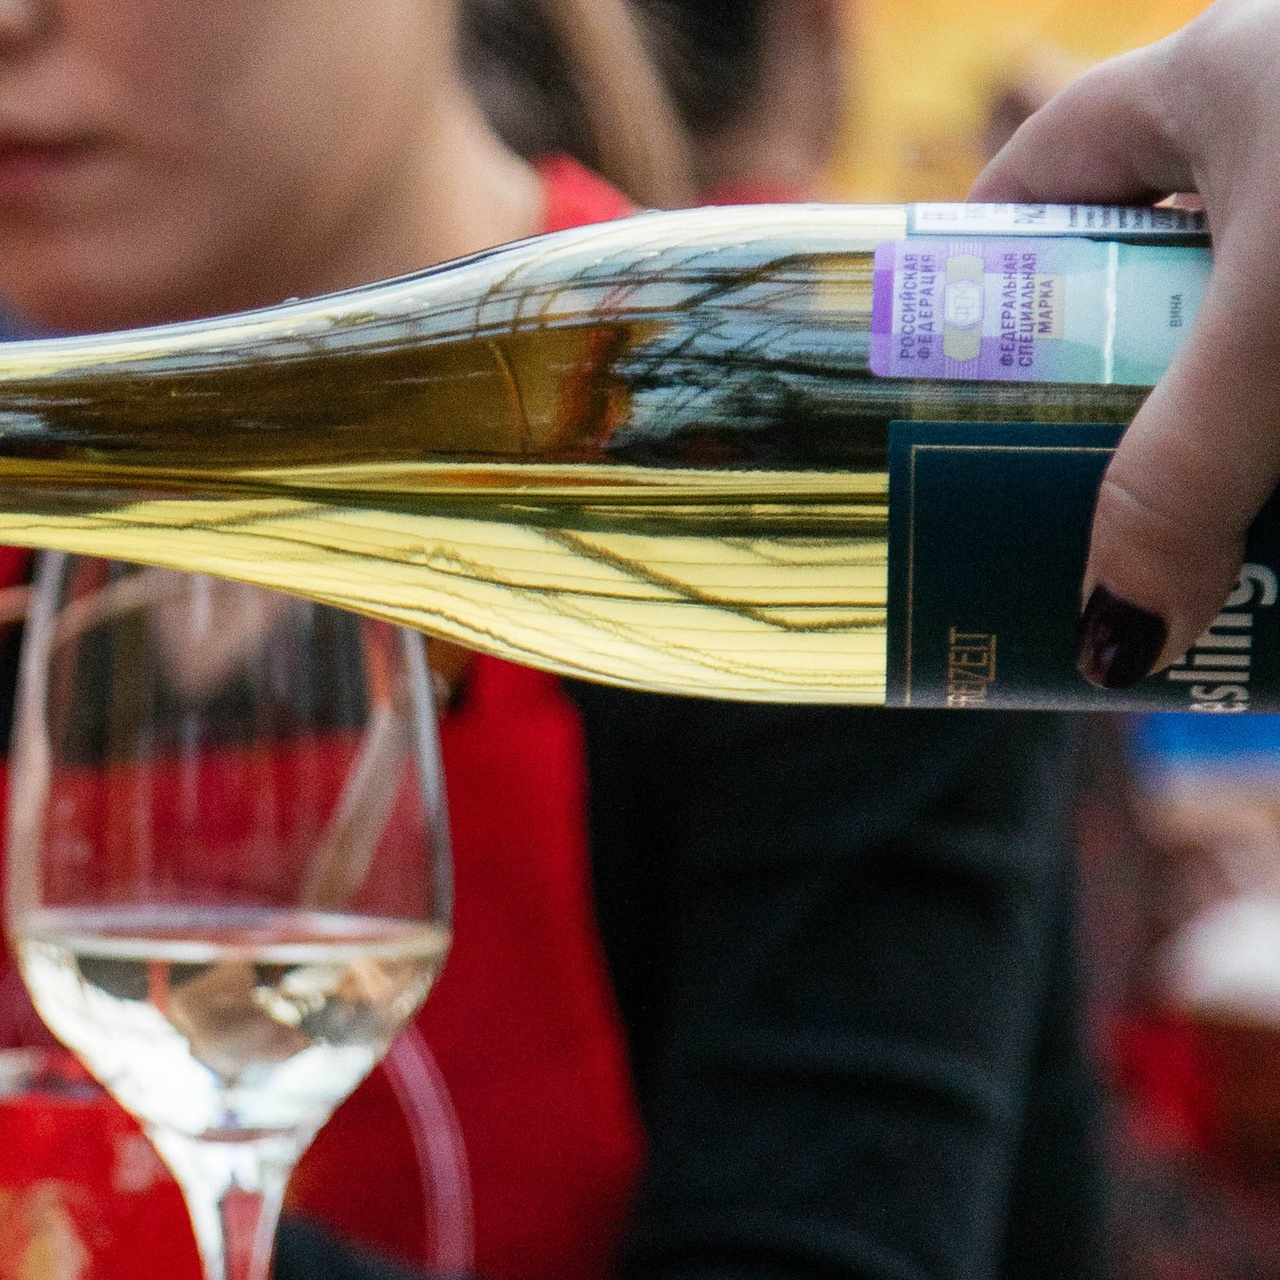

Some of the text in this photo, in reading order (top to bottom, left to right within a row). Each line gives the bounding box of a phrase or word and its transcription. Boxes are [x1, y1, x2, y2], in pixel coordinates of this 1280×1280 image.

[899, 253, 917, 359] РОССИЙСКАЯ
[918, 253, 936, 359] ФЕДЕРАЦИЯ
[999, 252, 1018, 367] ФЕДЕРАЛЬНАЯ
[1018, 252, 1037, 367] СПЕЦИАЛЬНАЯ
[1037, 278, 1054, 334] МАРКА
